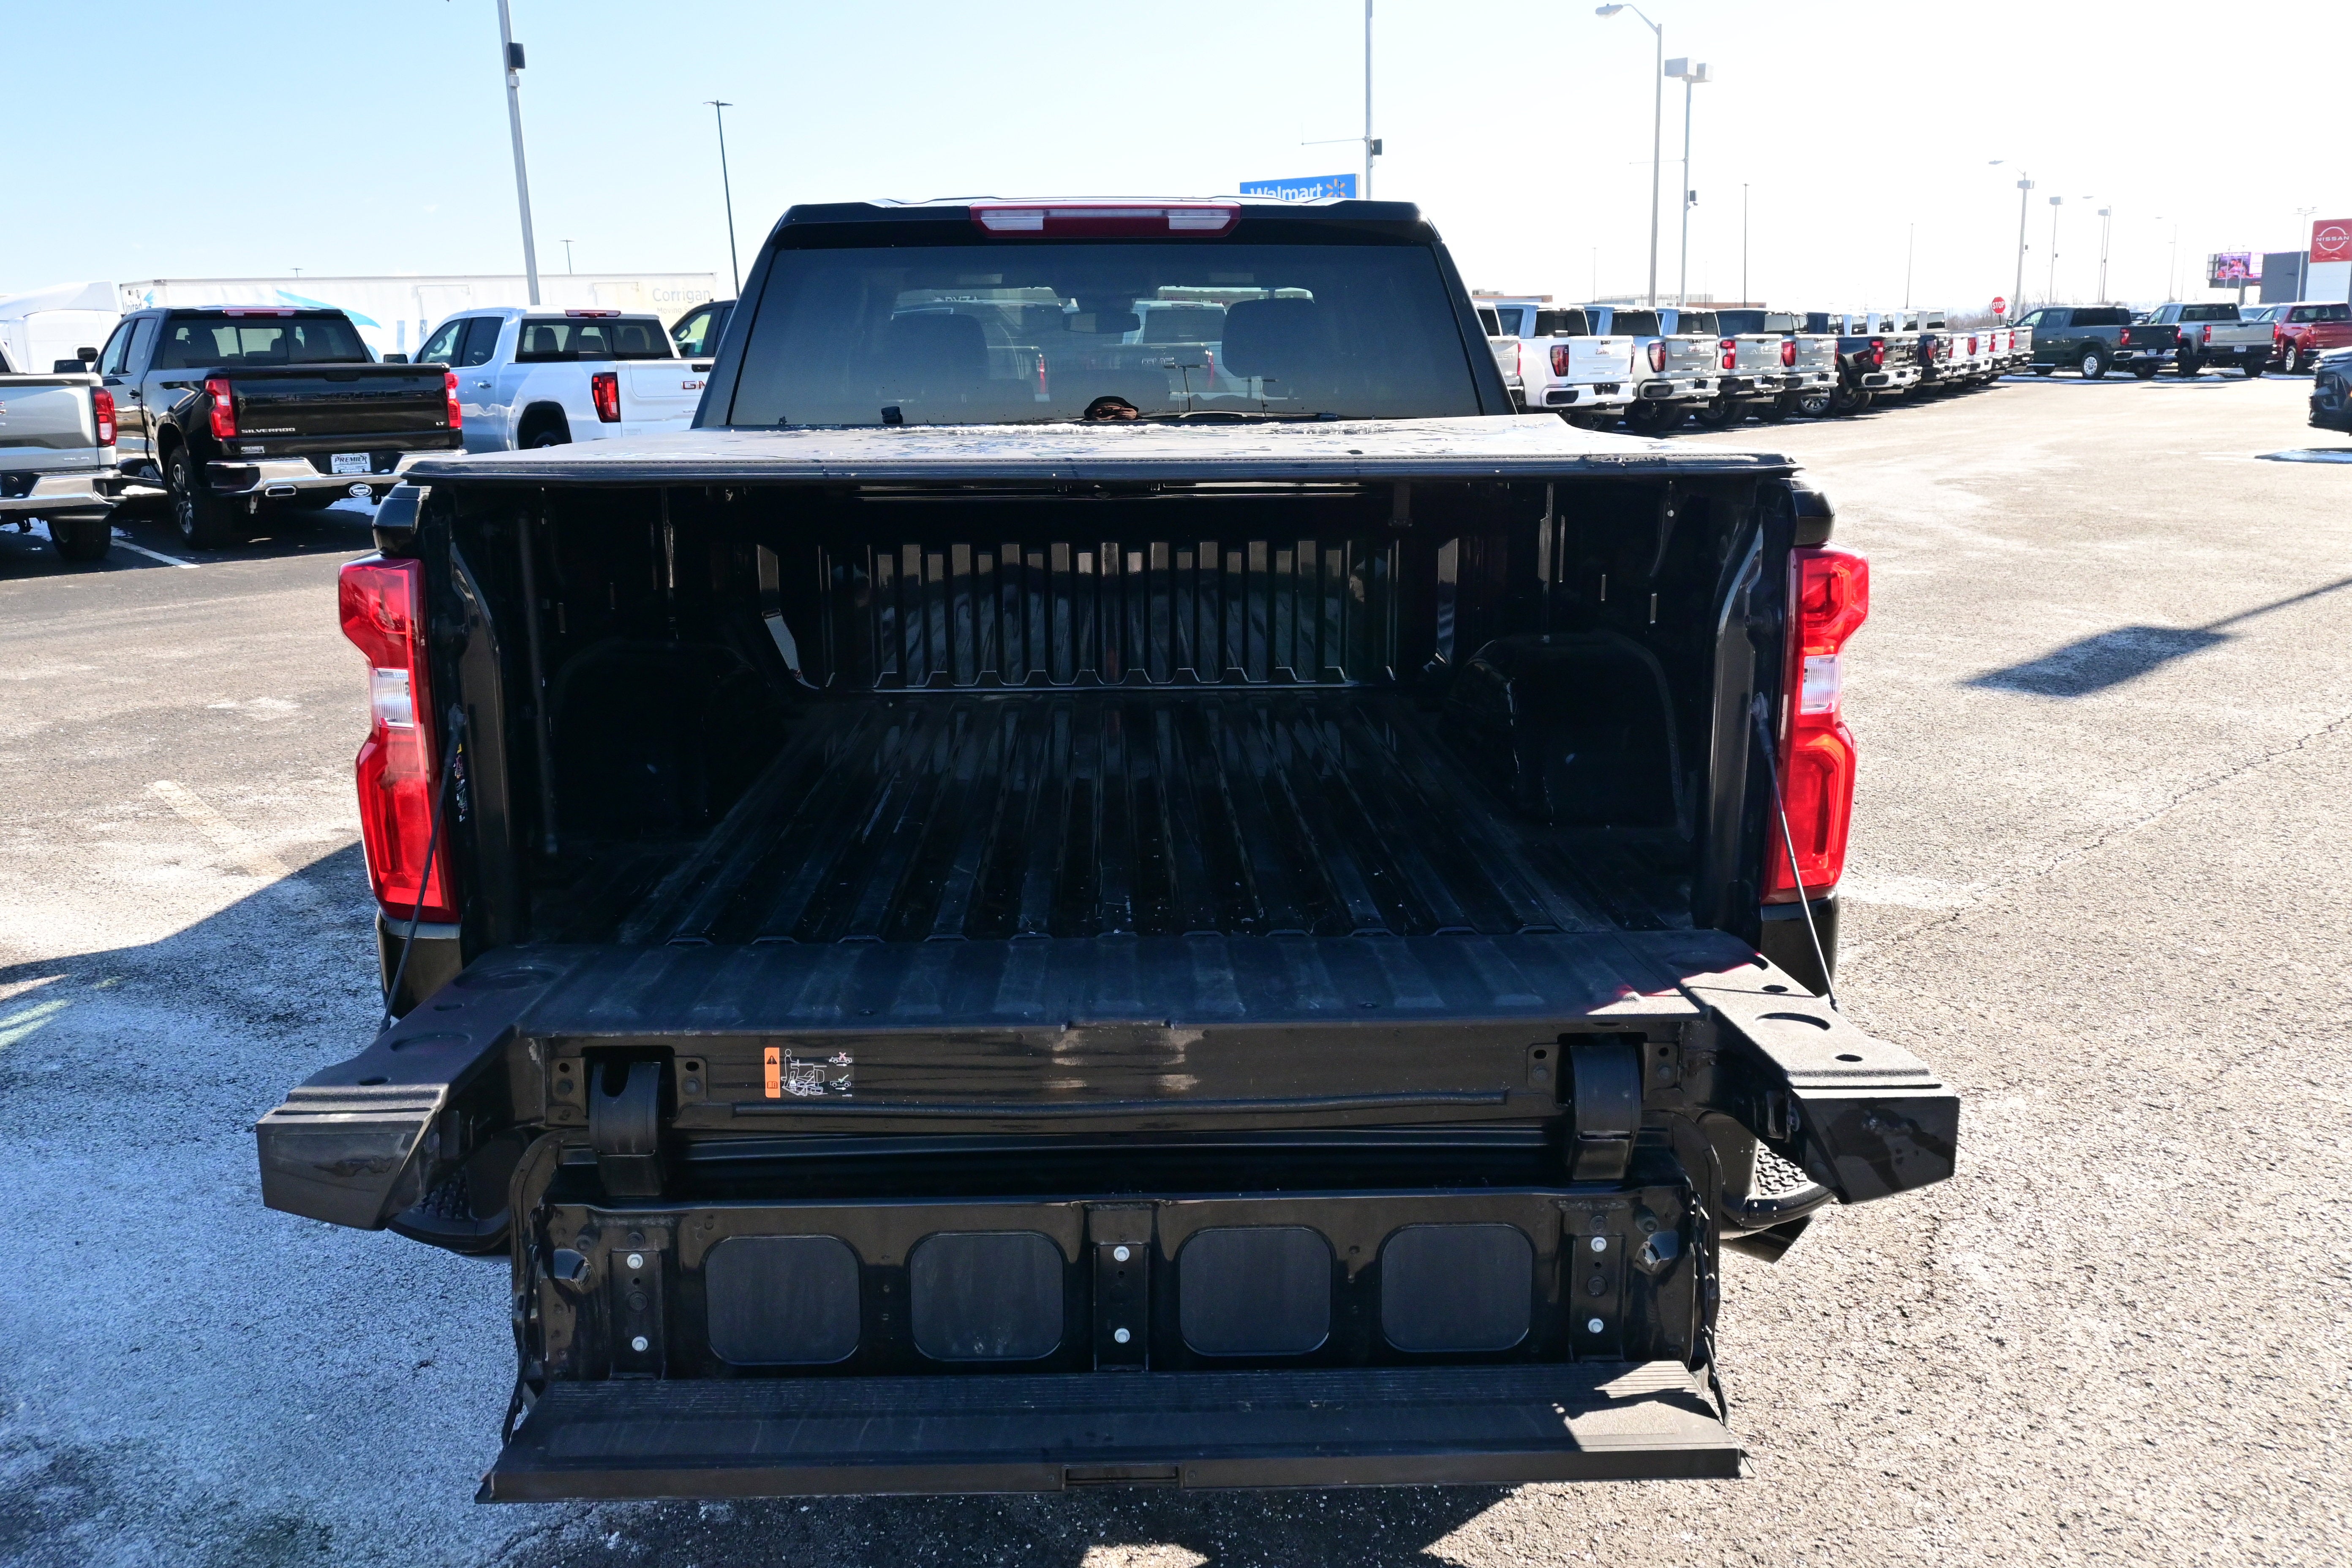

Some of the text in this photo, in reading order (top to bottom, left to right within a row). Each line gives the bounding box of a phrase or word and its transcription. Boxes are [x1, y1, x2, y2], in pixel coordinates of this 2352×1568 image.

[653, 288, 710, 303] Corrigan
[122, 299, 142, 315] United
[1992, 301, 2005, 309] STOP
[681, 380, 706, 389] GM
